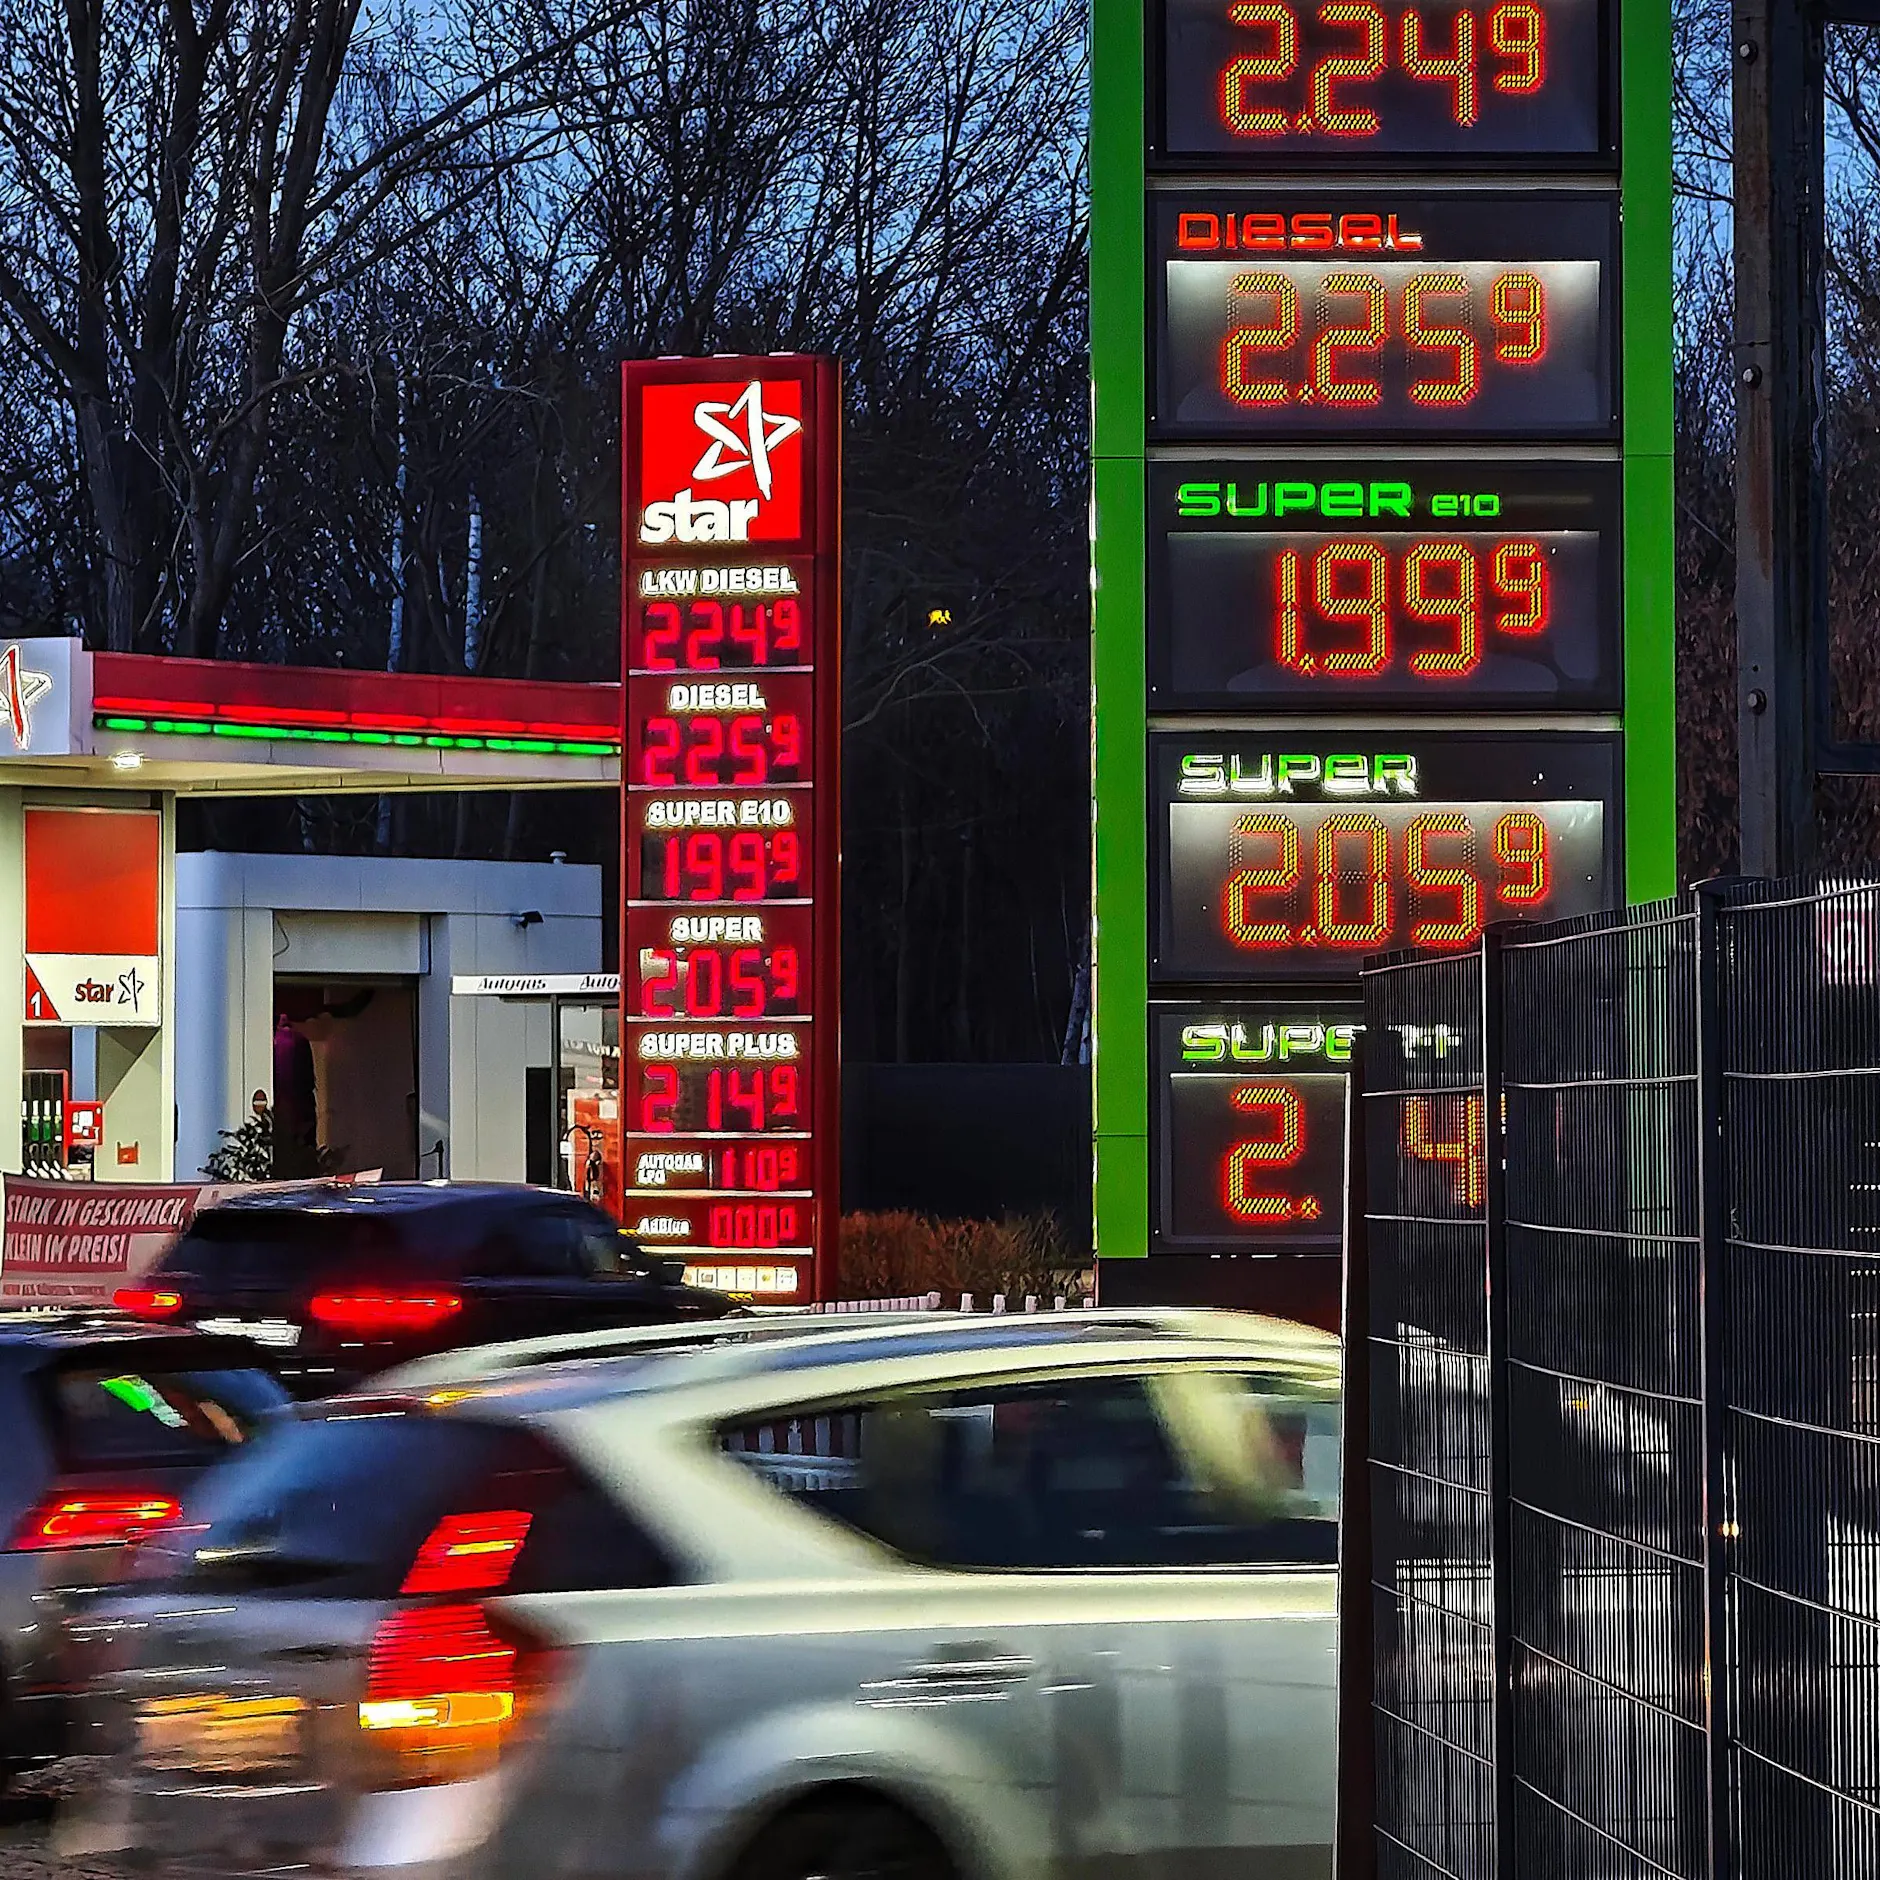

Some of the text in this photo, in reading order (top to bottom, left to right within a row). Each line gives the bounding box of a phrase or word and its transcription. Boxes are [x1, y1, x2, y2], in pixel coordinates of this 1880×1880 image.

[640, 488, 759, 543] star
[641, 567, 798, 595] LKW DIESEL
[668, 684, 766, 710] DIESEL
[646, 799, 793, 826] SUPER E10
[669, 916, 764, 943] SUPER
[75, 978, 114, 1003] star
[477, 977, 547, 991] Autogas
[30, 991, 42, 1017] 1
[640, 1033, 725, 1058] SUPER
[727, 1033, 797, 1057] PLUS
[6, 1195, 53, 1225] STARK
[54, 1198, 80, 1226] IM
[4, 1232, 43, 1261] KLEIN
[44, 1233, 67, 1263] IM
